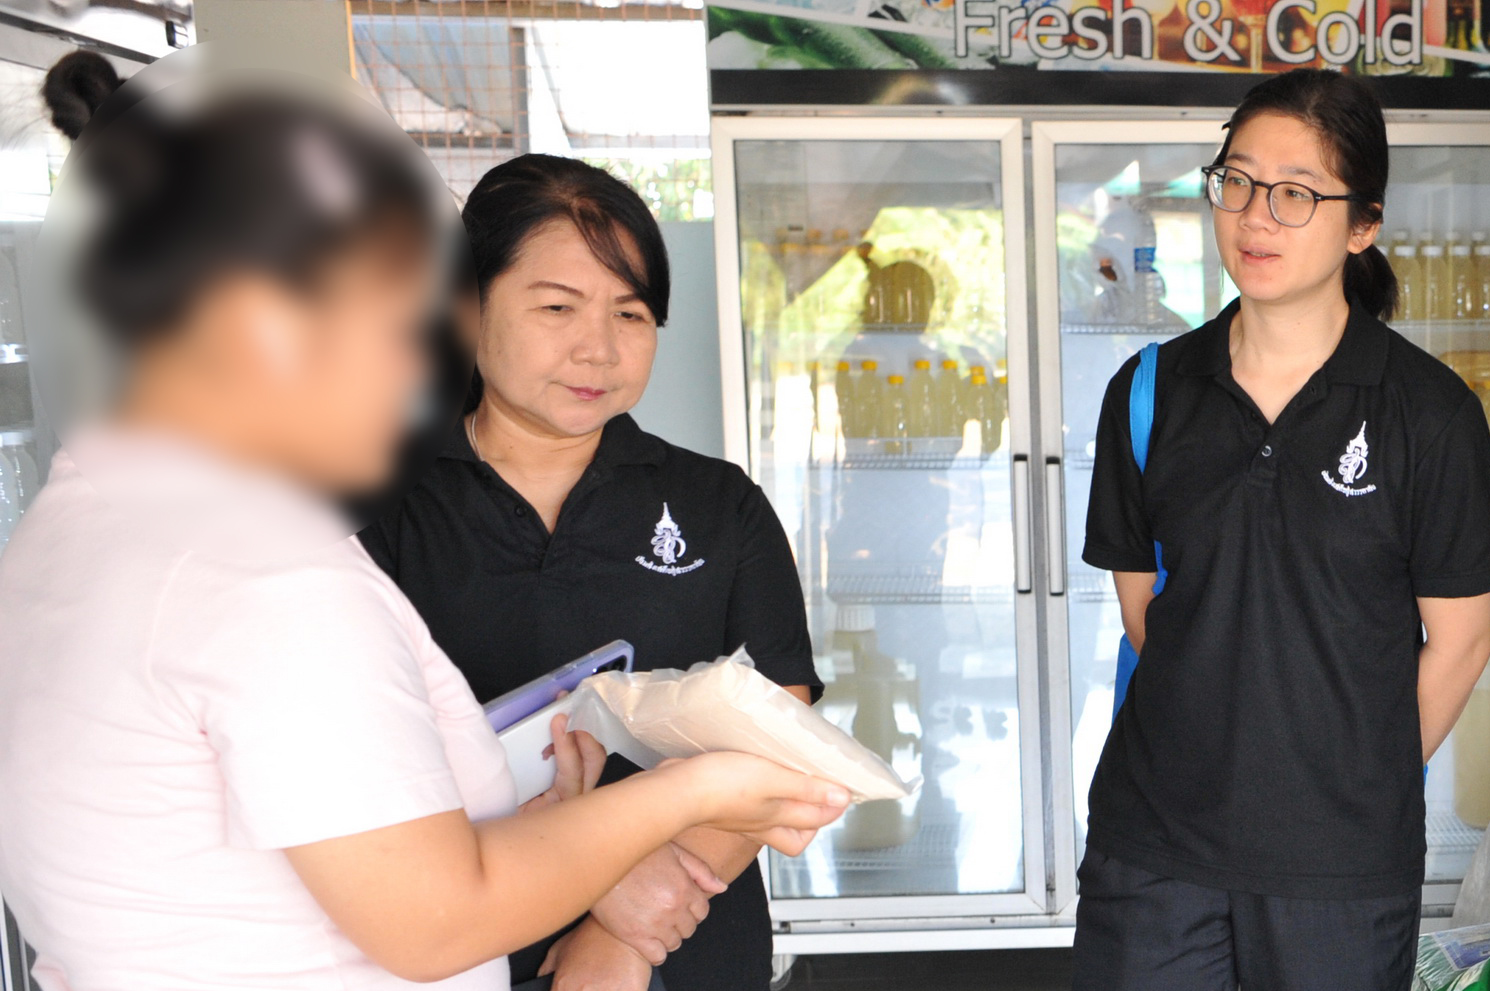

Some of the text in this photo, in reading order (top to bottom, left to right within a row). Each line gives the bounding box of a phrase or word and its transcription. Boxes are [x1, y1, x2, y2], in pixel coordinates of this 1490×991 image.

[953, 0, 1424, 66] Fresh & Cold
